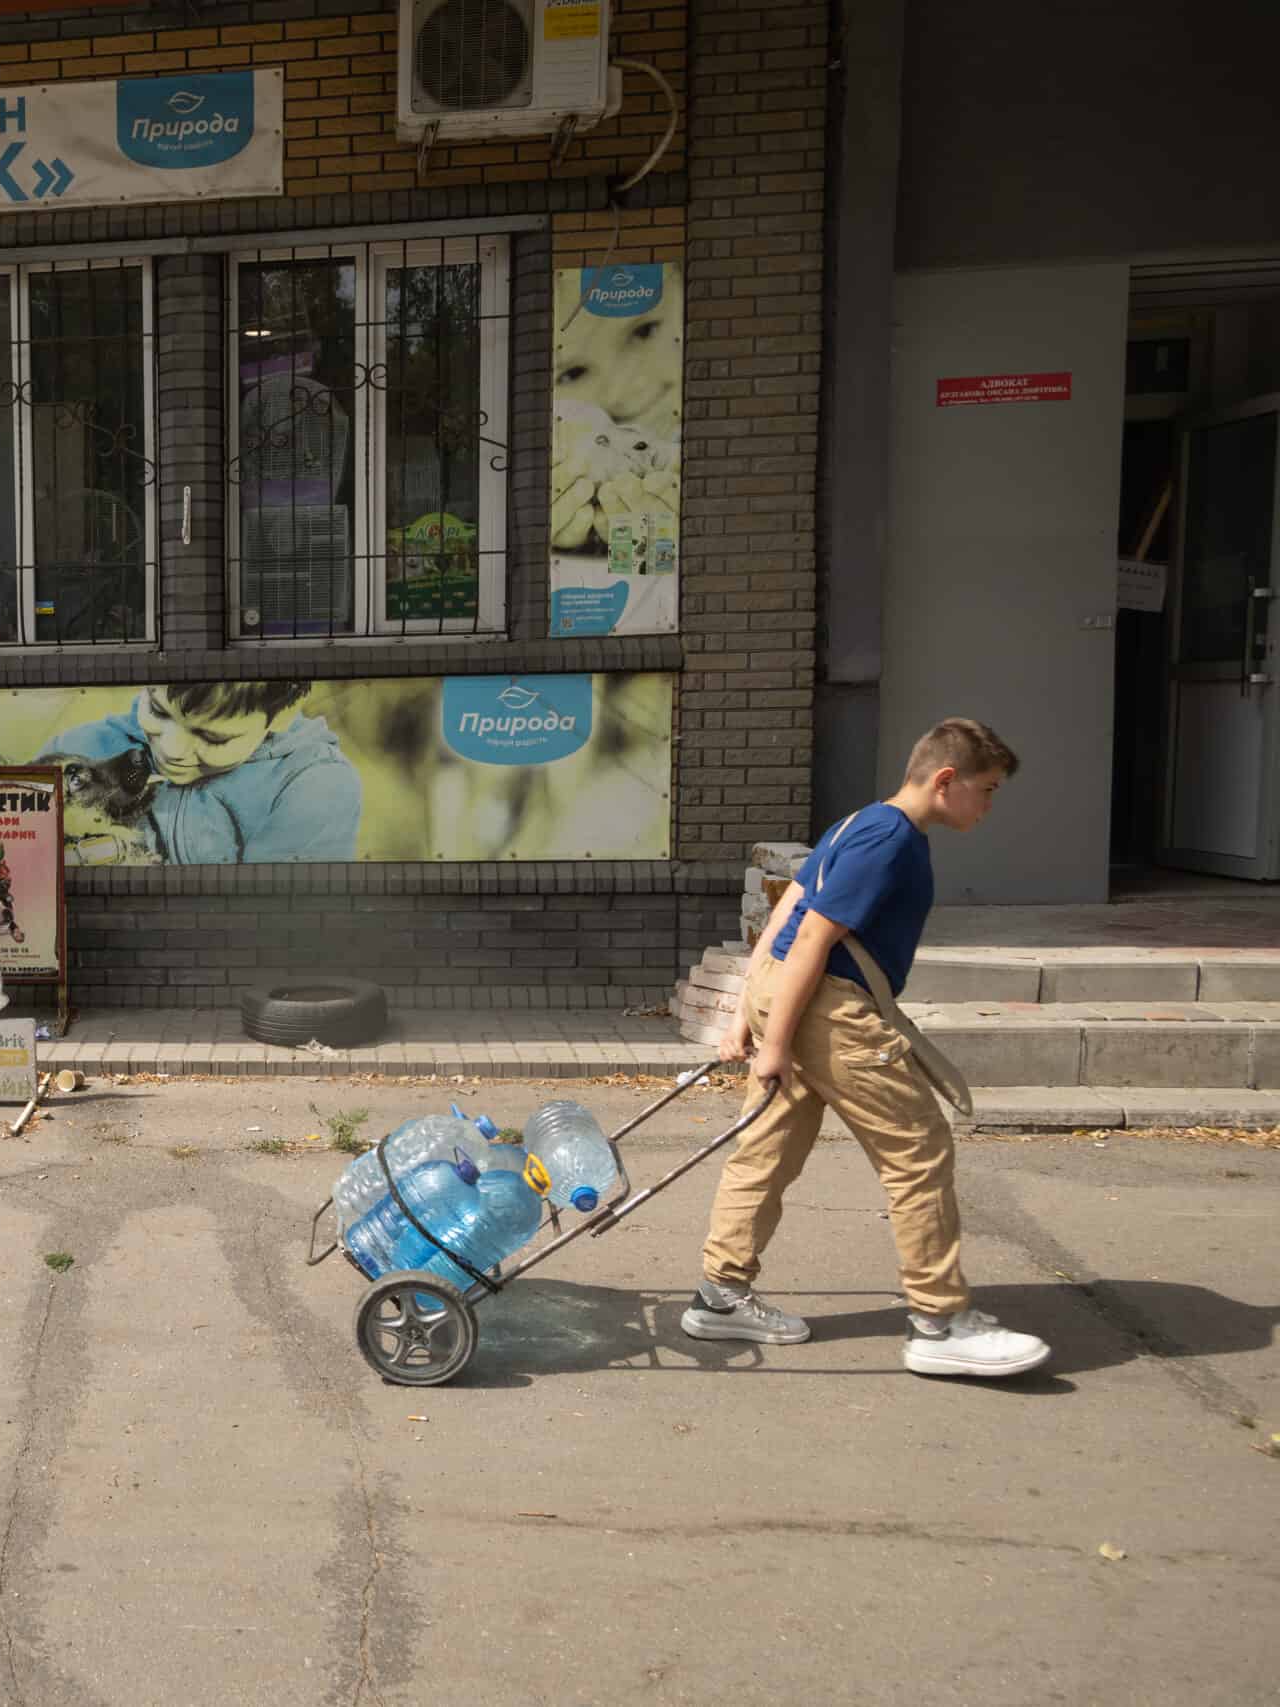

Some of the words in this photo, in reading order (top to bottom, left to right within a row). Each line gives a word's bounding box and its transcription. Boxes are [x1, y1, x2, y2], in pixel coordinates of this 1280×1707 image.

[131, 112, 240, 143] Природа
[589, 286, 655, 304] Природа
[459, 710, 576, 737] Природа
